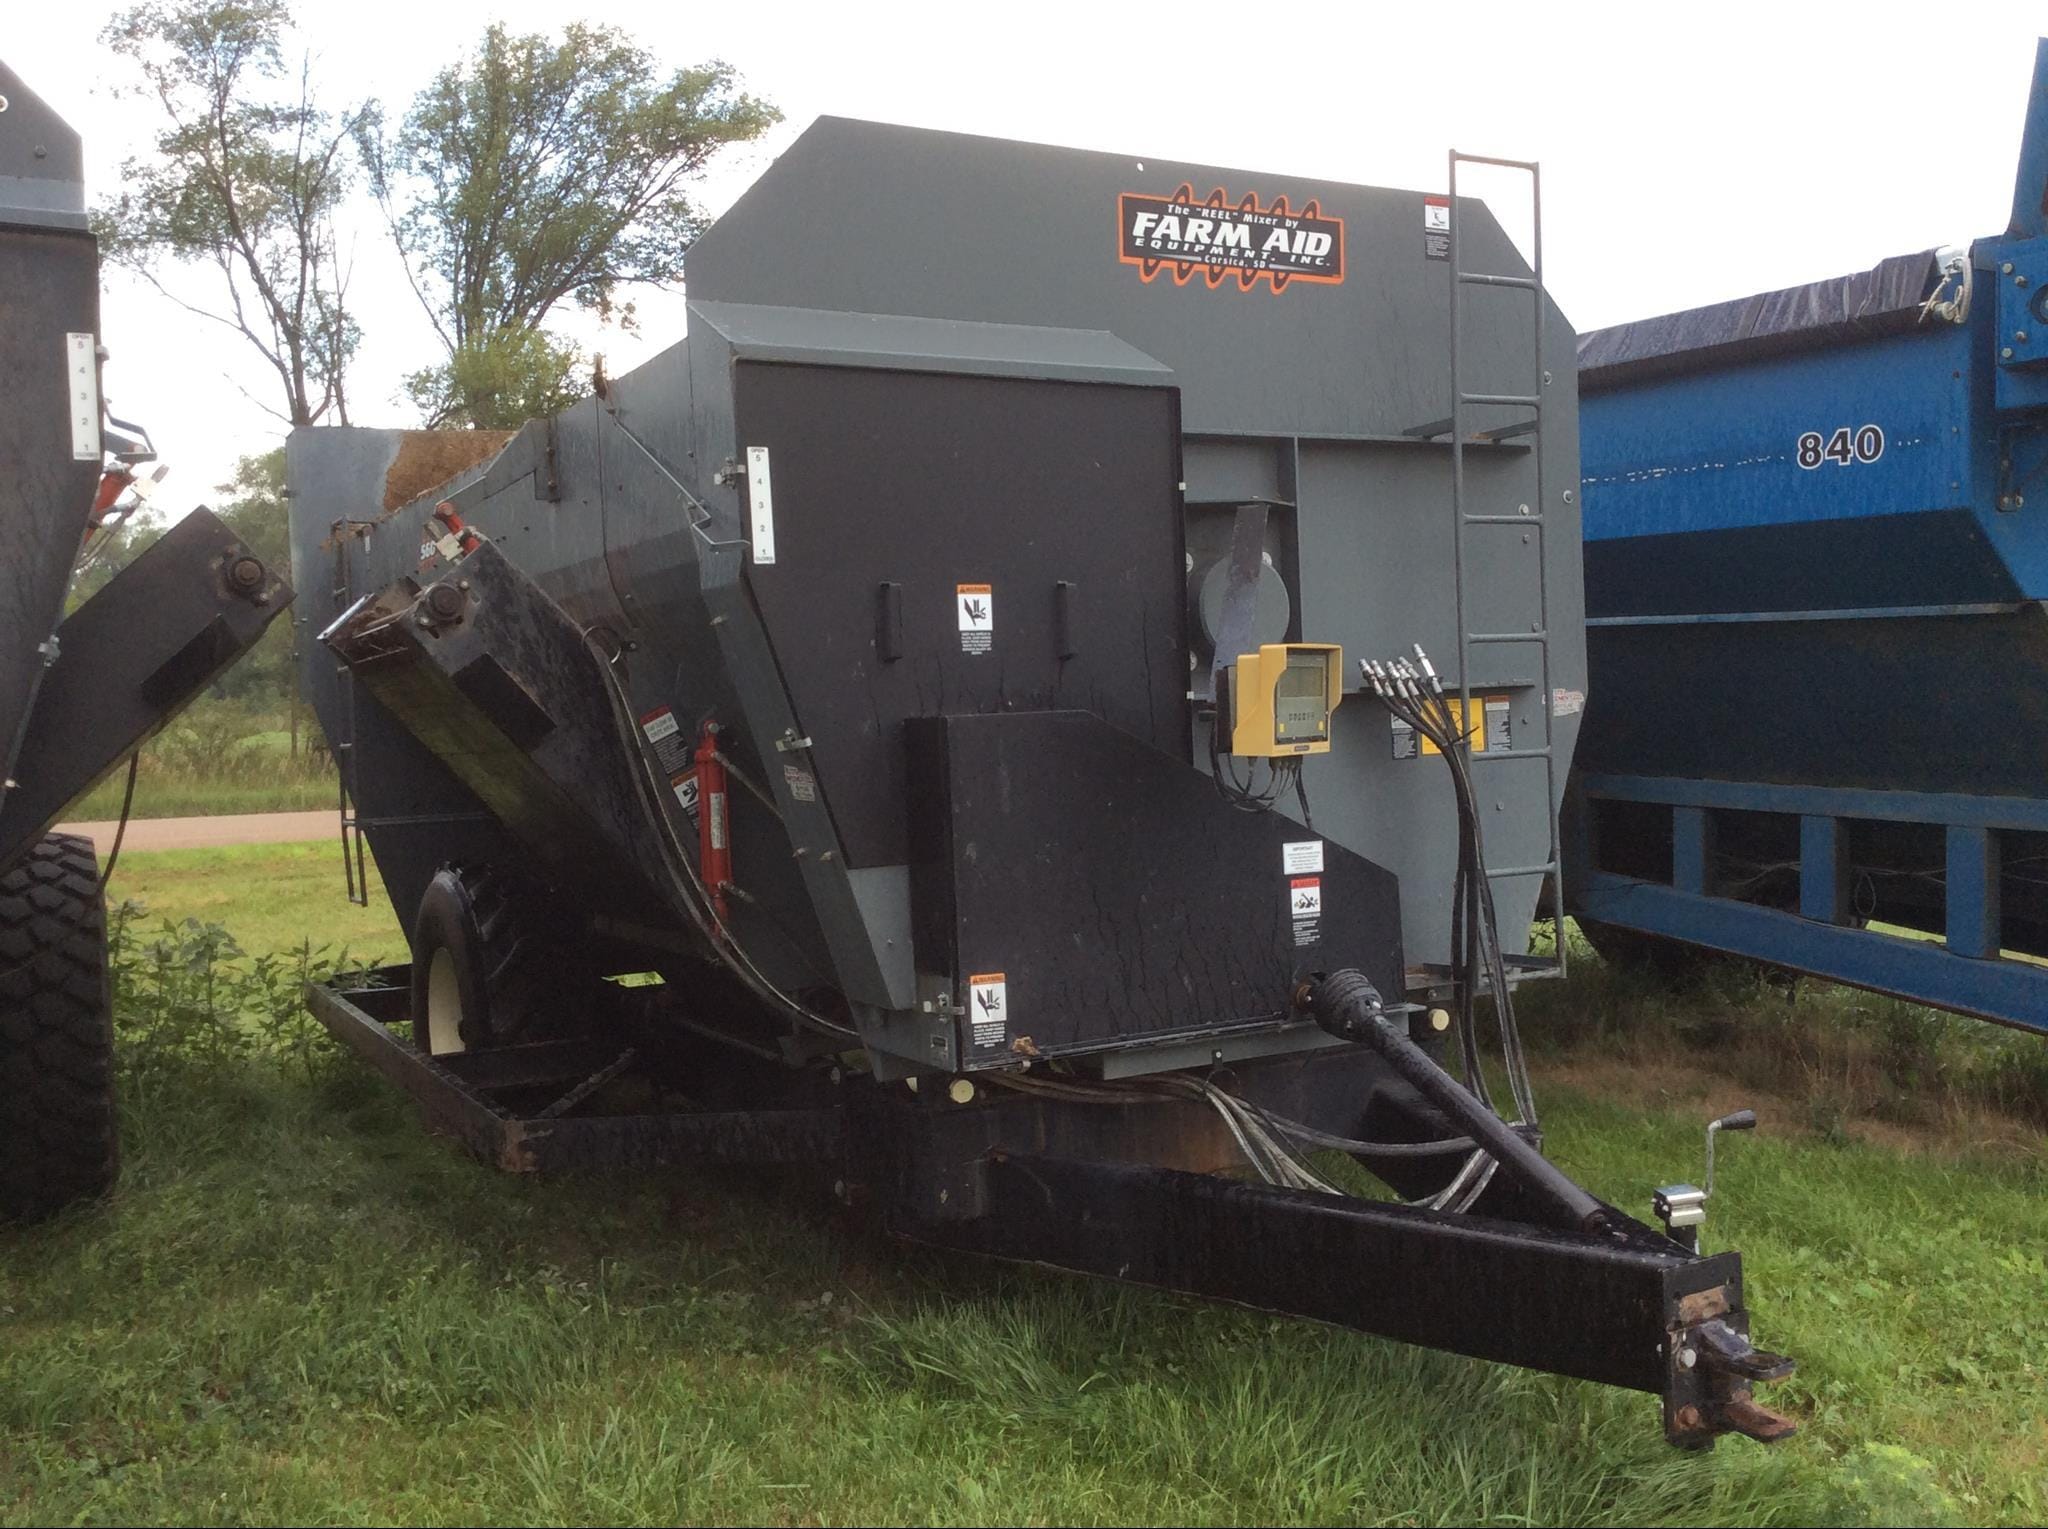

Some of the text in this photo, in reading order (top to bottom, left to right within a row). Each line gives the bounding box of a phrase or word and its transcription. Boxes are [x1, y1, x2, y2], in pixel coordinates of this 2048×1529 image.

[1168, 204, 1190, 215] The
[1243, 213, 1278, 226] Mixer
[1285, 218, 1298, 229] by
[1132, 211, 1332, 257] FARM AID
[79, 366, 86, 374] 4
[81, 392, 87, 400] 3
[82, 418, 88, 426] 2
[1797, 424, 1885, 470] 840
[755, 454, 761, 462] 5
[759, 501, 764, 509] 3
